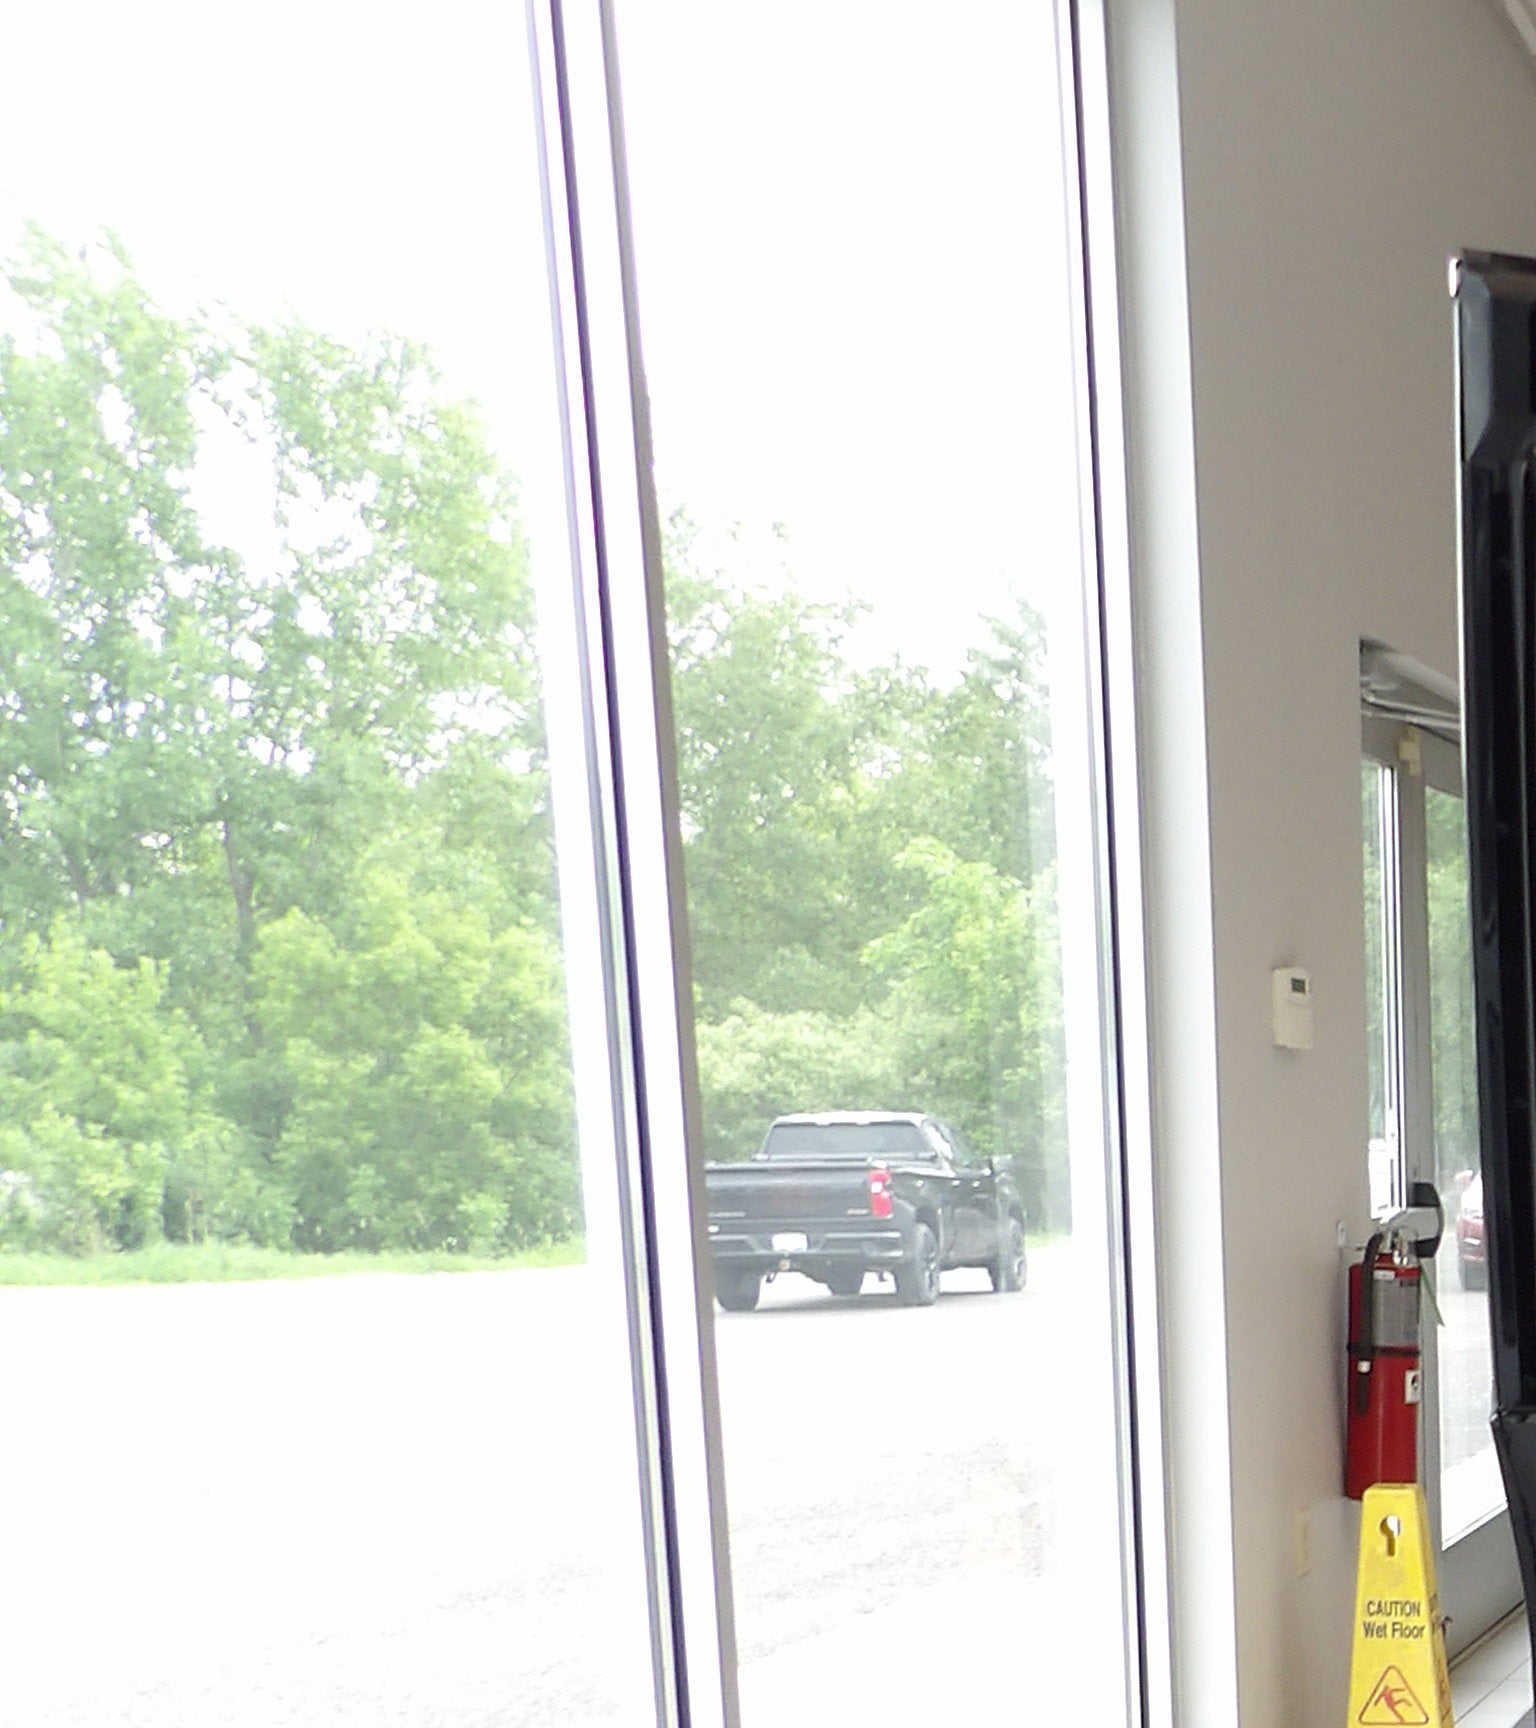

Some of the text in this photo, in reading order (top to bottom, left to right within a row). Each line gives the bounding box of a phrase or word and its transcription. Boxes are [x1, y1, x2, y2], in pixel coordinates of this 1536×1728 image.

[1367, 1600, 1420, 1617] CAUTION
[1363, 1622, 1426, 1639] Wet Floor
